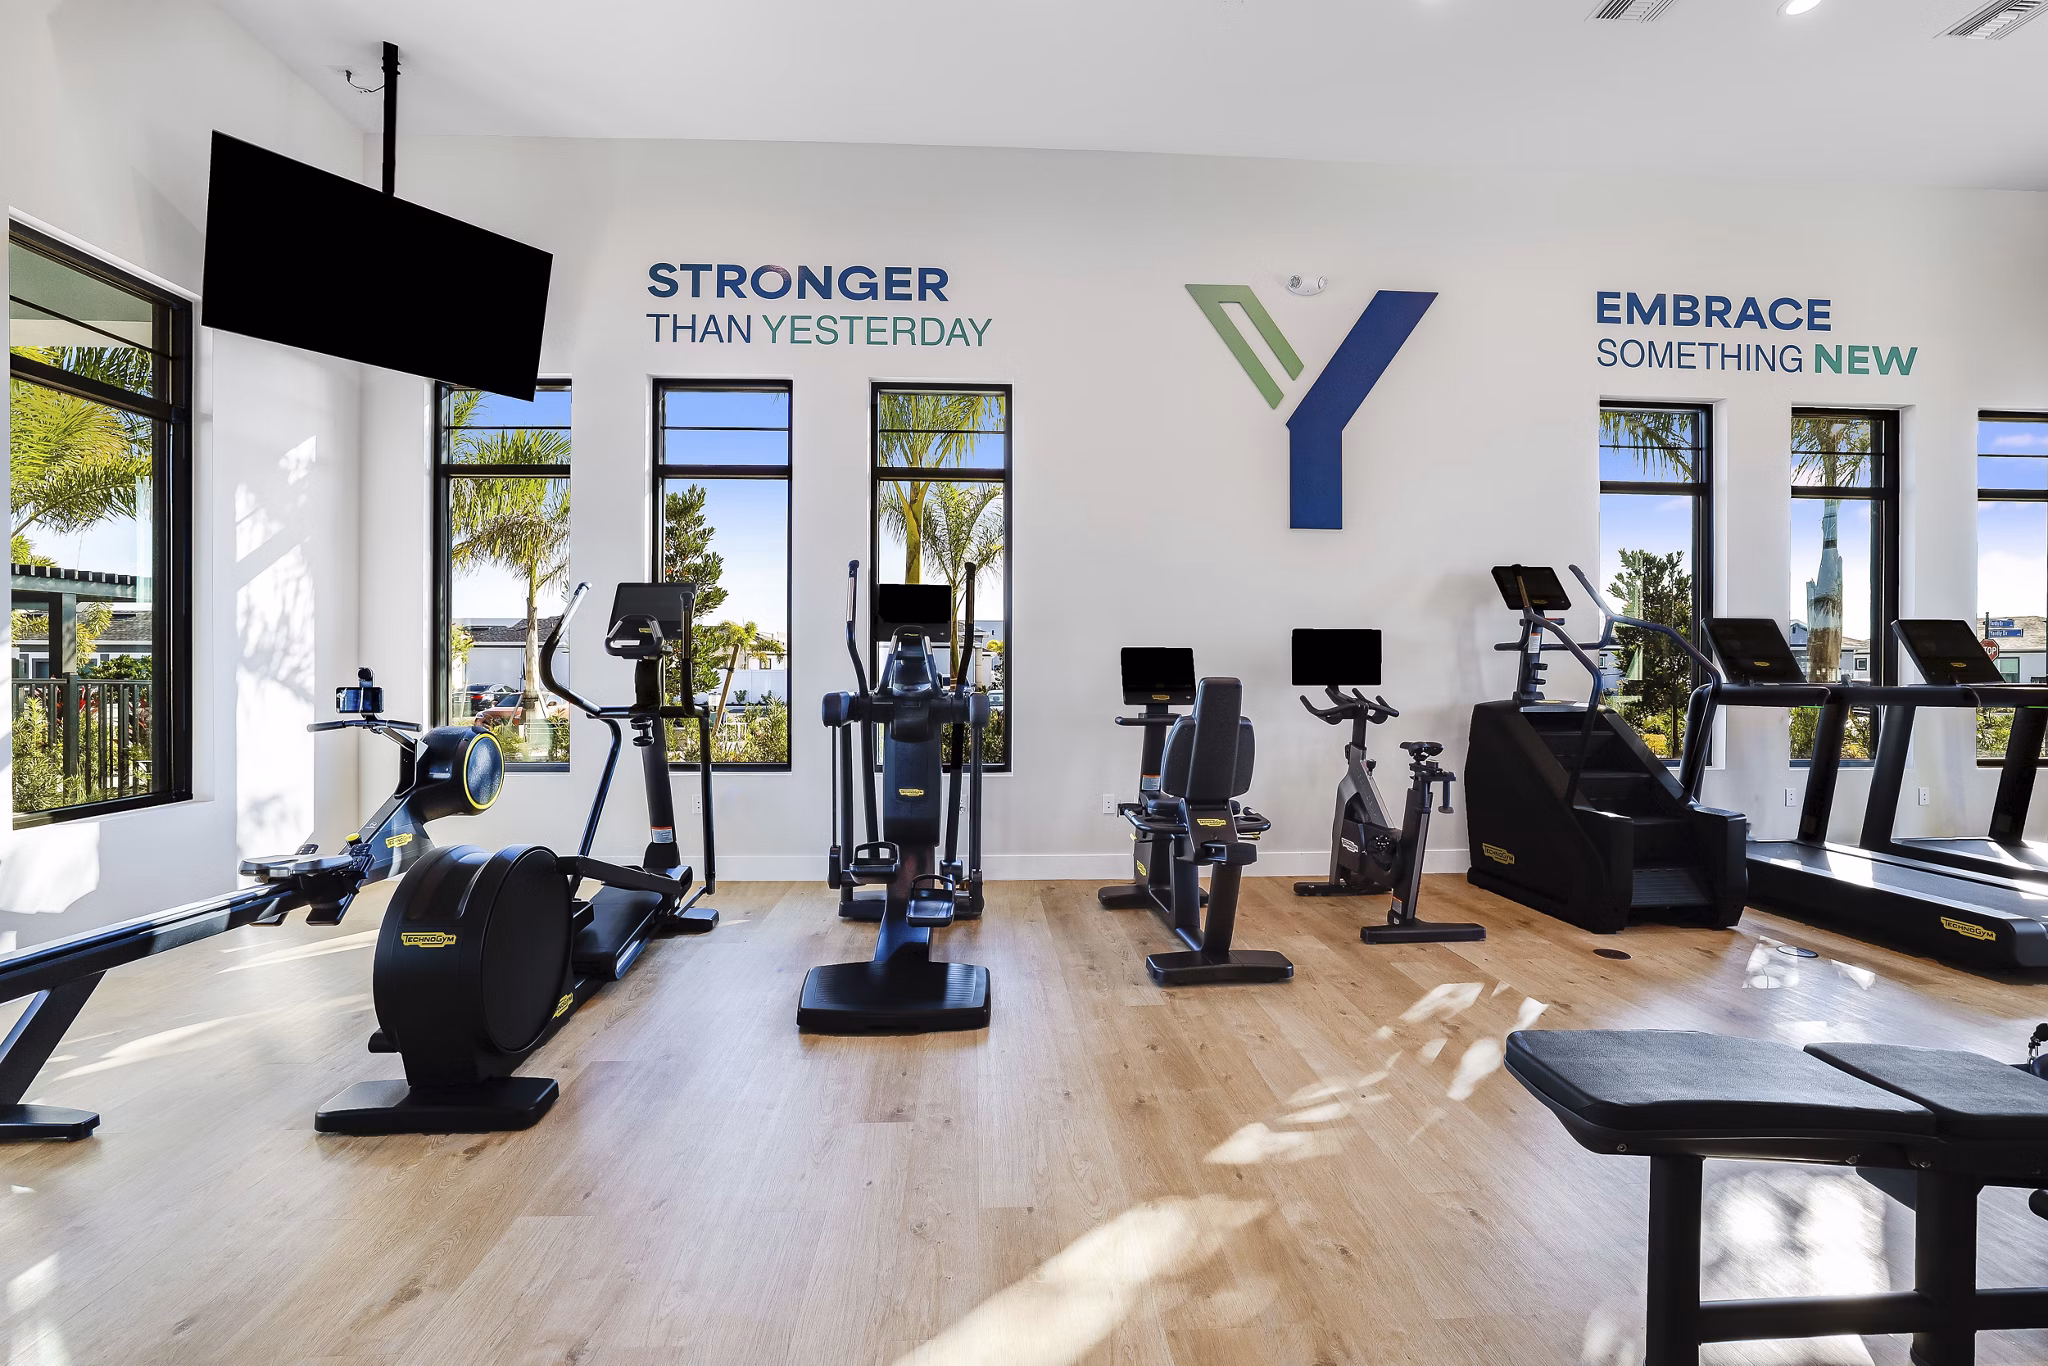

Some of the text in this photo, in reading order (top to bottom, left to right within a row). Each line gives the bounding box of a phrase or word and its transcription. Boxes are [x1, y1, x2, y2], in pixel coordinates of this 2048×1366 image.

[647, 262, 949, 301] STRONGER
[646, 313, 993, 347] THAN YESTERDAY
[1597, 291, 1831, 331] EMBRACE
[1597, 338, 1918, 376] SOMETHING NEW
[1983, 646, 1997, 655] TOP
